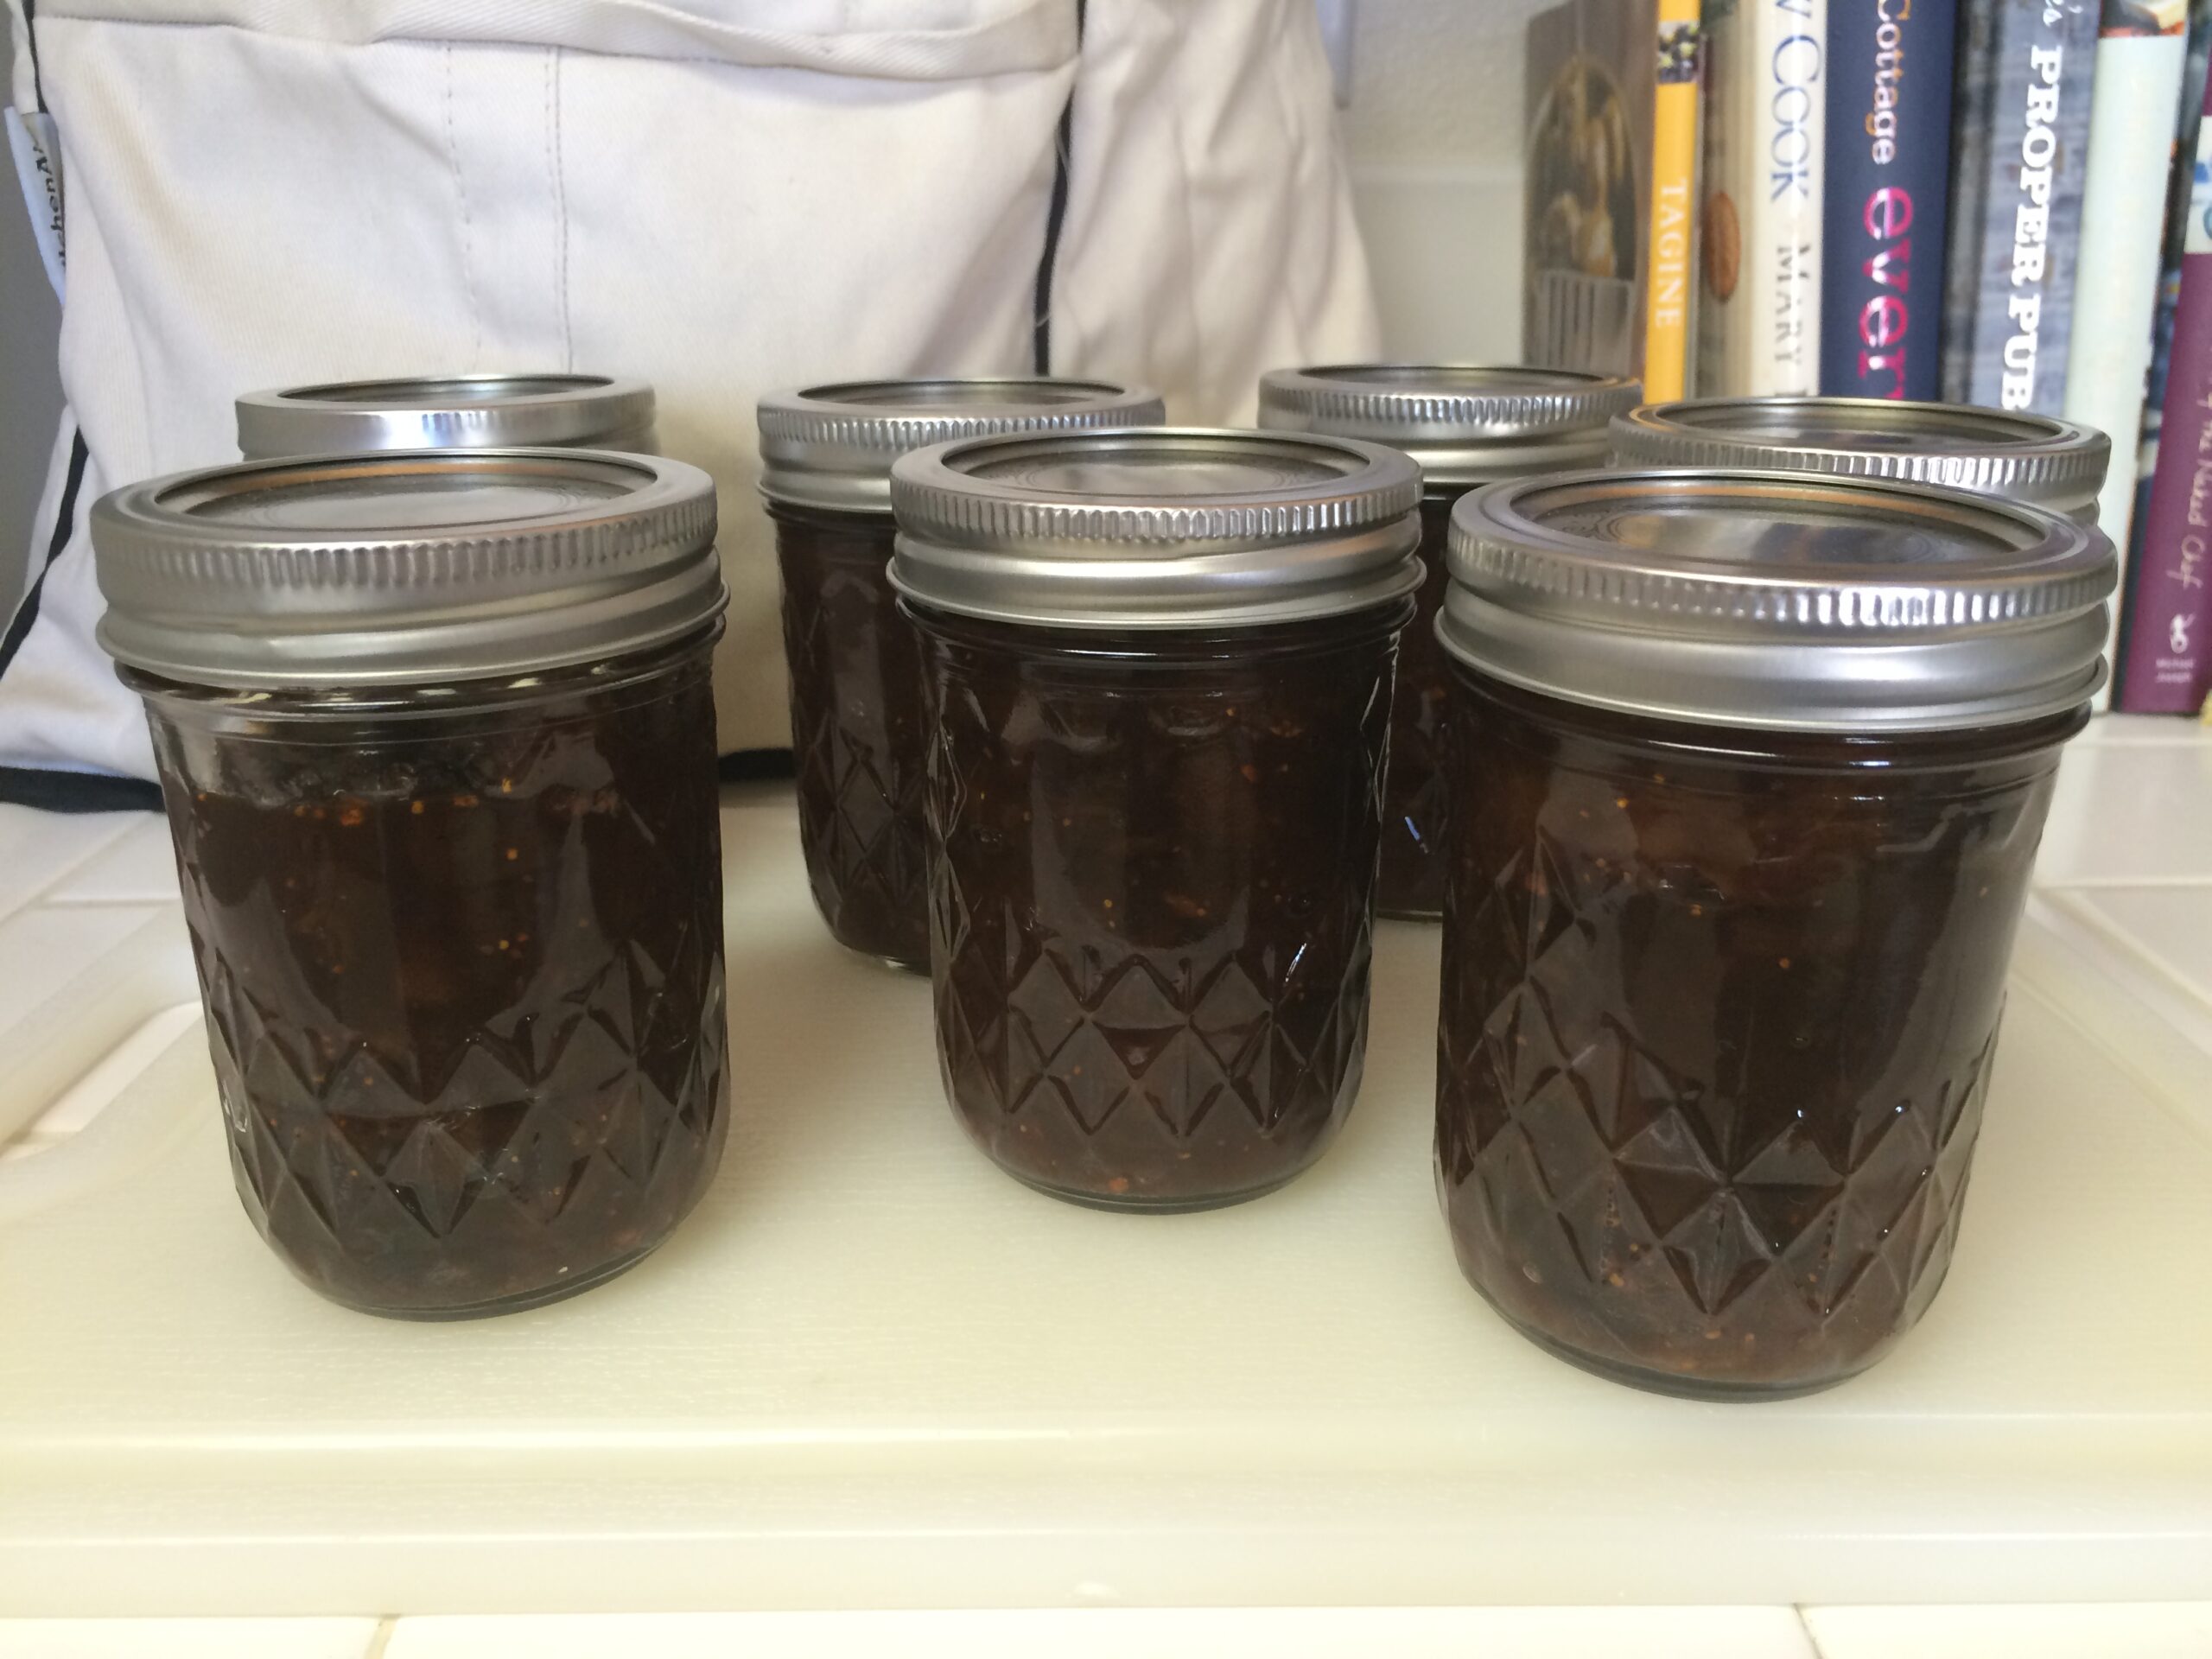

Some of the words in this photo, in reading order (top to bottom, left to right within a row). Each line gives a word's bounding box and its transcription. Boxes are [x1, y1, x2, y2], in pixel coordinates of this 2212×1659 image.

[1770, 34, 1821, 203] COOK
[1865, 0, 1911, 164] Cottage
[2011, 45, 2063, 288] PROPER
[1655, 177, 1688, 328] TAGINE
[1774, 245, 1811, 365] MARY
[1859, 187, 1913, 399] ever
[2001, 293, 2042, 410] PUB
